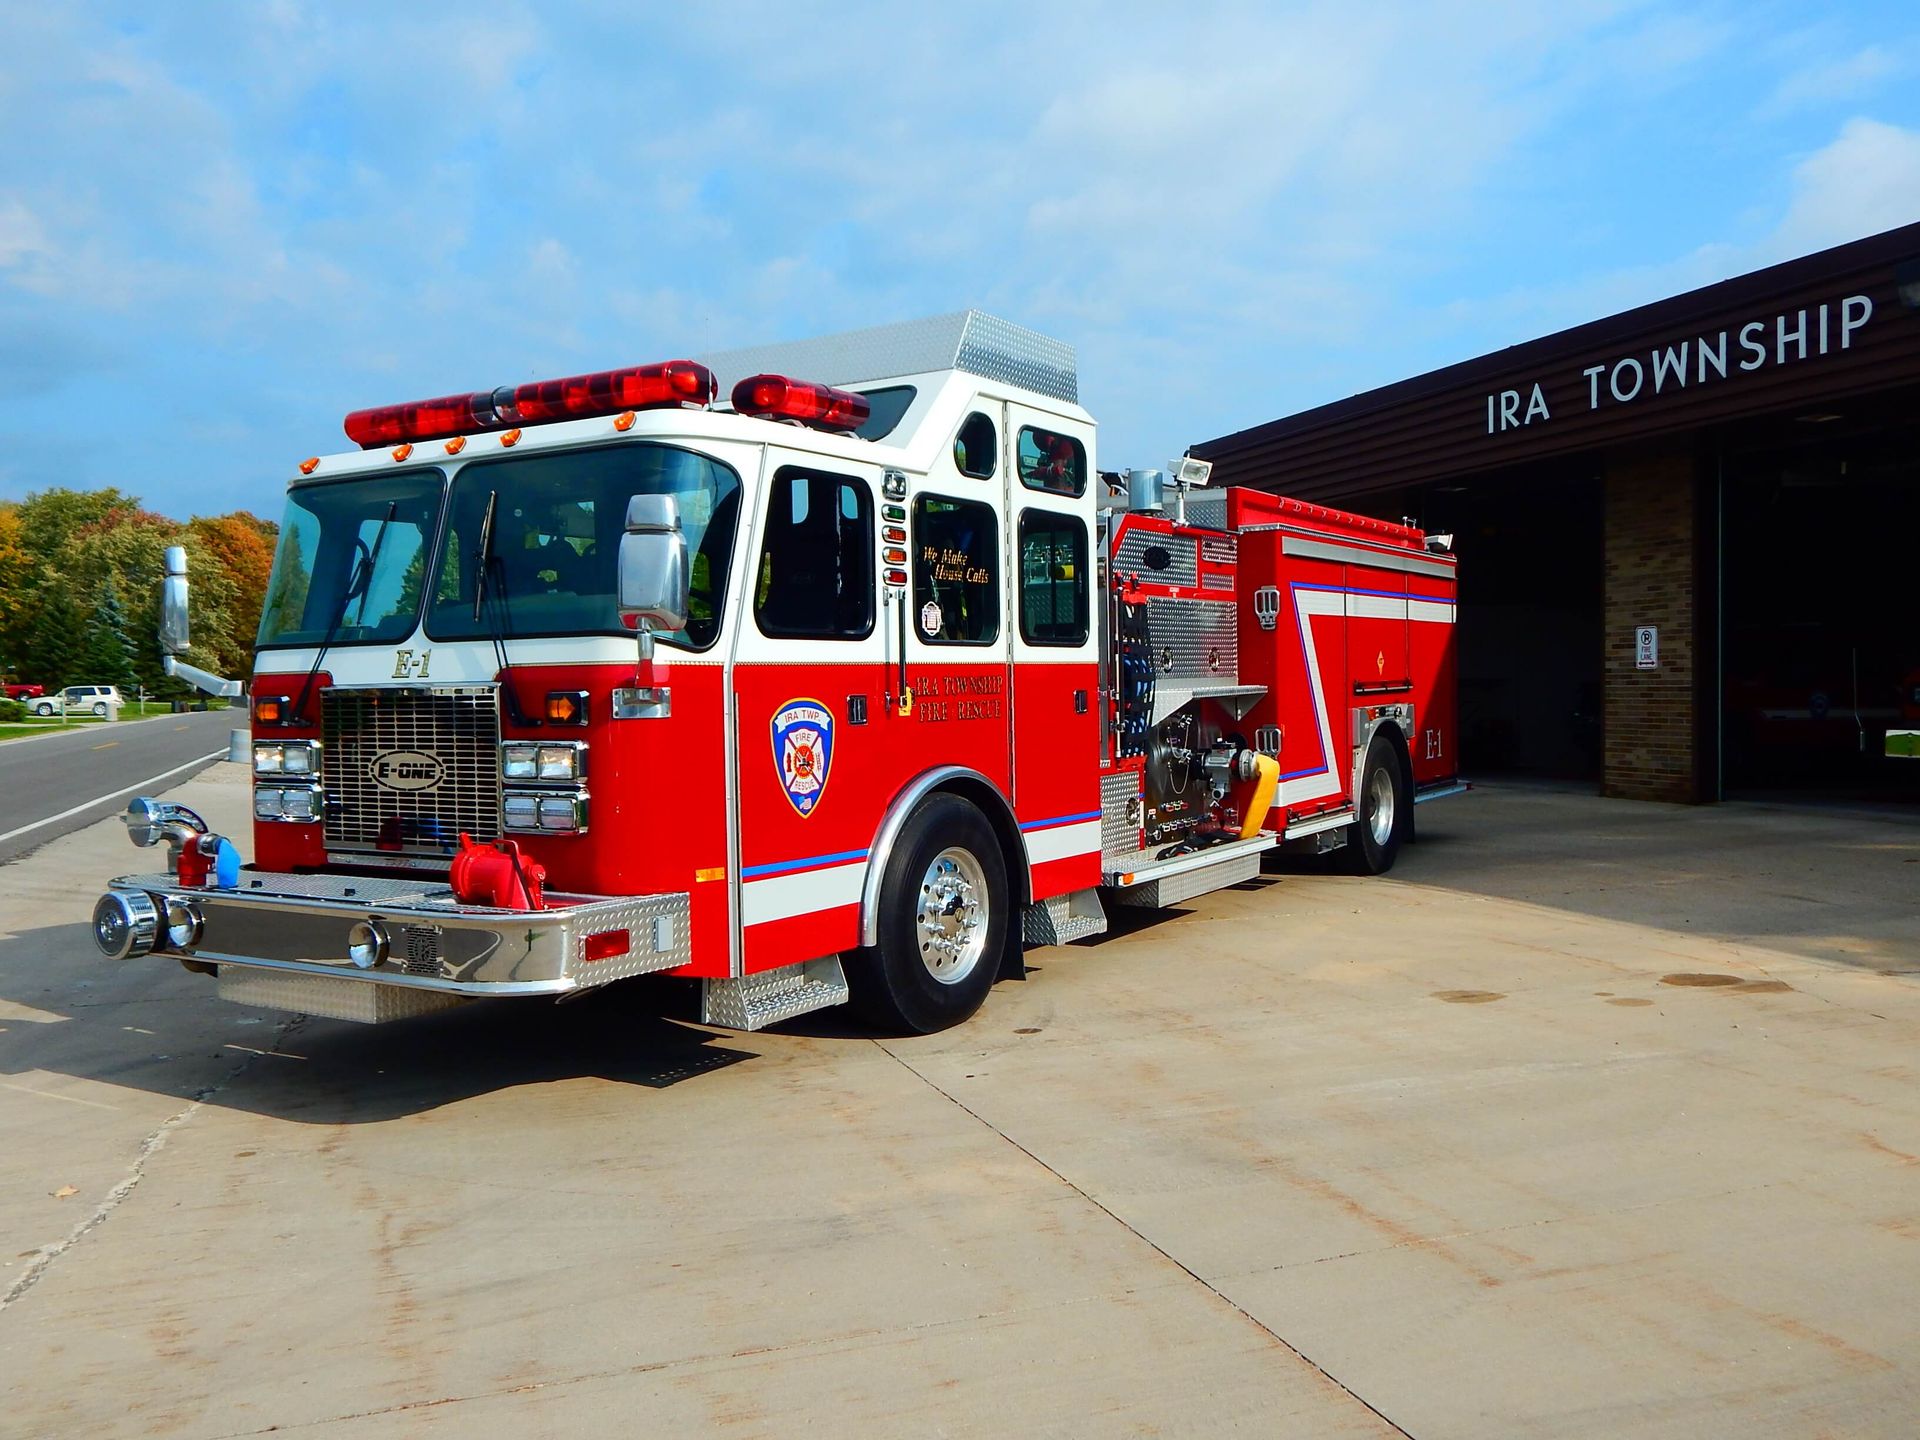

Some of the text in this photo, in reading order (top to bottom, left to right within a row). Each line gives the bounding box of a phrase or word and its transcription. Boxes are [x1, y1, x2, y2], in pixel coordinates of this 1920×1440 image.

[1487, 295, 1873, 434] IRA TOWNSHIP
[923, 546, 968, 566] We Make
[966, 567, 989, 584] Calls
[391, 648, 432, 679] E-1
[916, 675, 1003, 696] IRA TOWNSHIP
[784, 710, 799, 724] IRA
[919, 699, 1001, 722] FIRE RESCUE
[795, 731, 811, 743] FIRE
[1425, 728, 1443, 760] E-1
[377, 762, 437, 780] E-ONE
[794, 778, 814, 791] RESCUE
